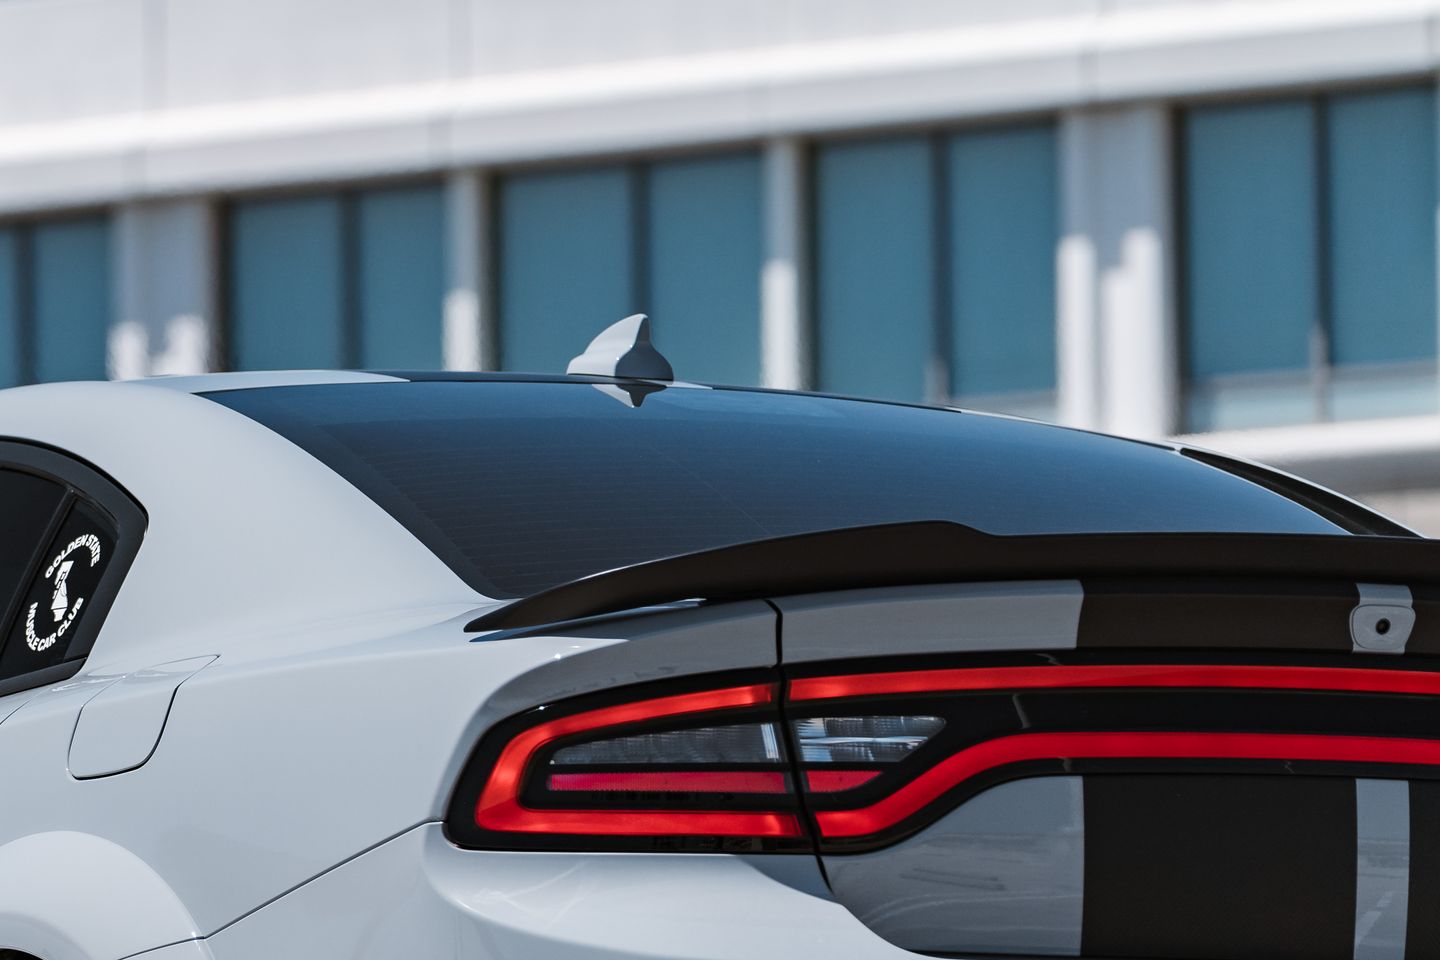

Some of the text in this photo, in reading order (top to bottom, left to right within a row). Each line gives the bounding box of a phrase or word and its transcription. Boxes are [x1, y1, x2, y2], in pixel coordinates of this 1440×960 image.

[44, 533, 101, 579] GOLDEN STATE
[25, 597, 84, 652] MUSCLE CAR CLUB
